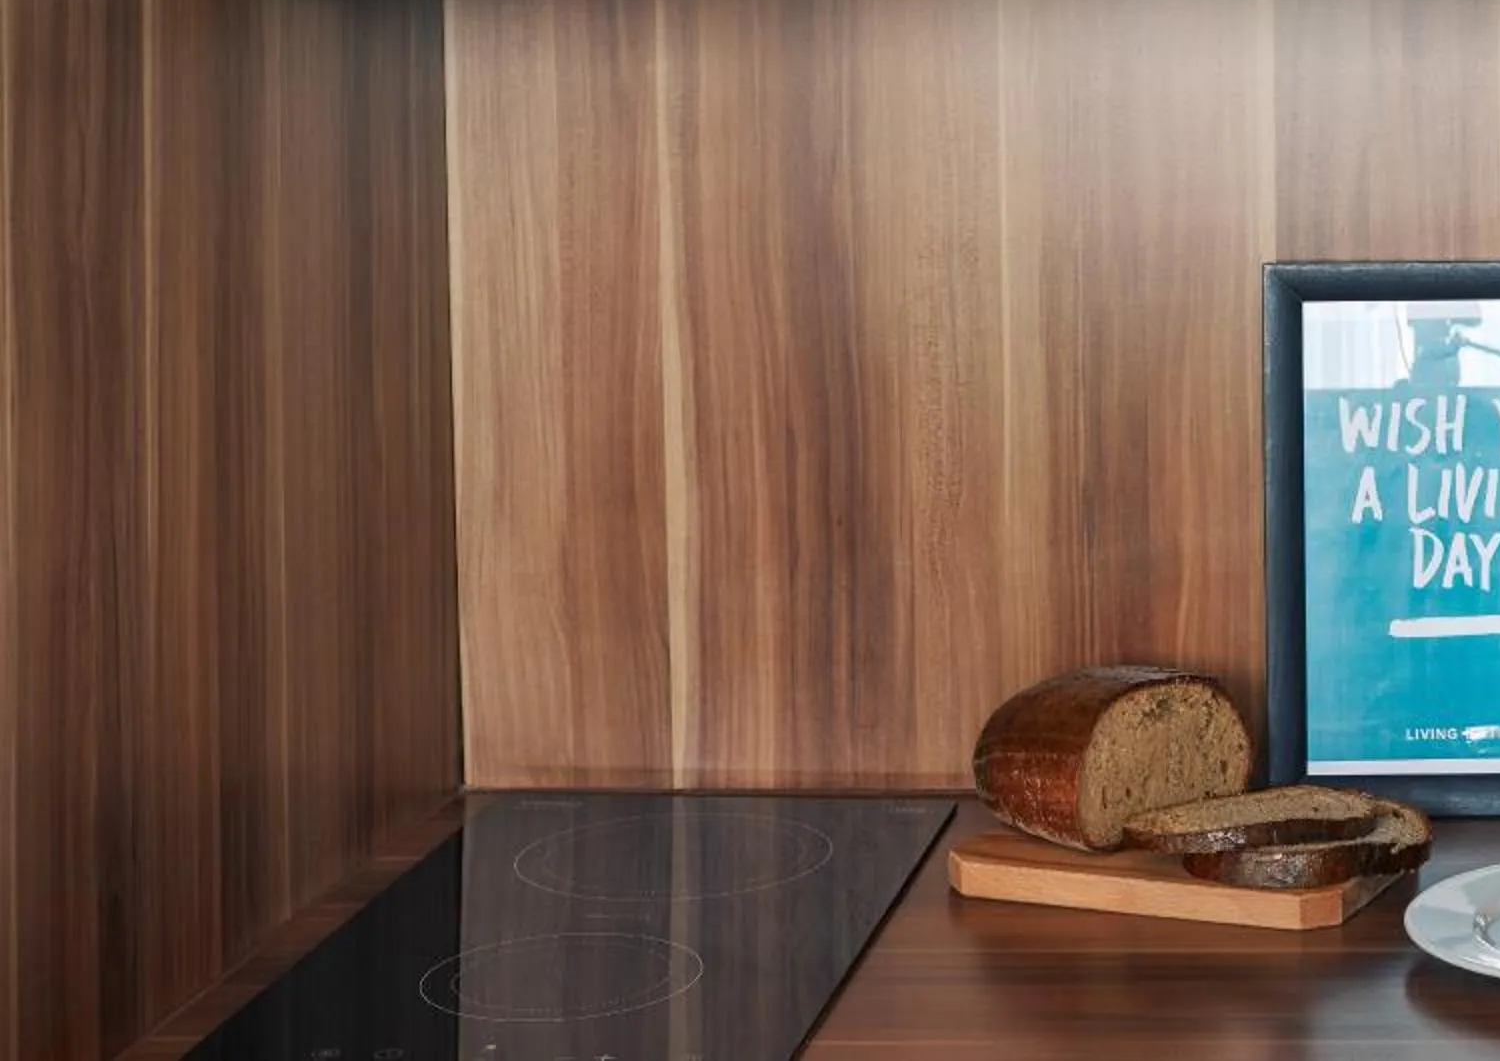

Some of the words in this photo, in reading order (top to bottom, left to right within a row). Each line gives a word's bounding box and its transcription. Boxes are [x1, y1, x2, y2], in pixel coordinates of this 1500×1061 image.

[1338, 393, 1467, 456] WISH
[1351, 464, 1383, 524] A
[1405, 727, 1458, 741] LIVING
